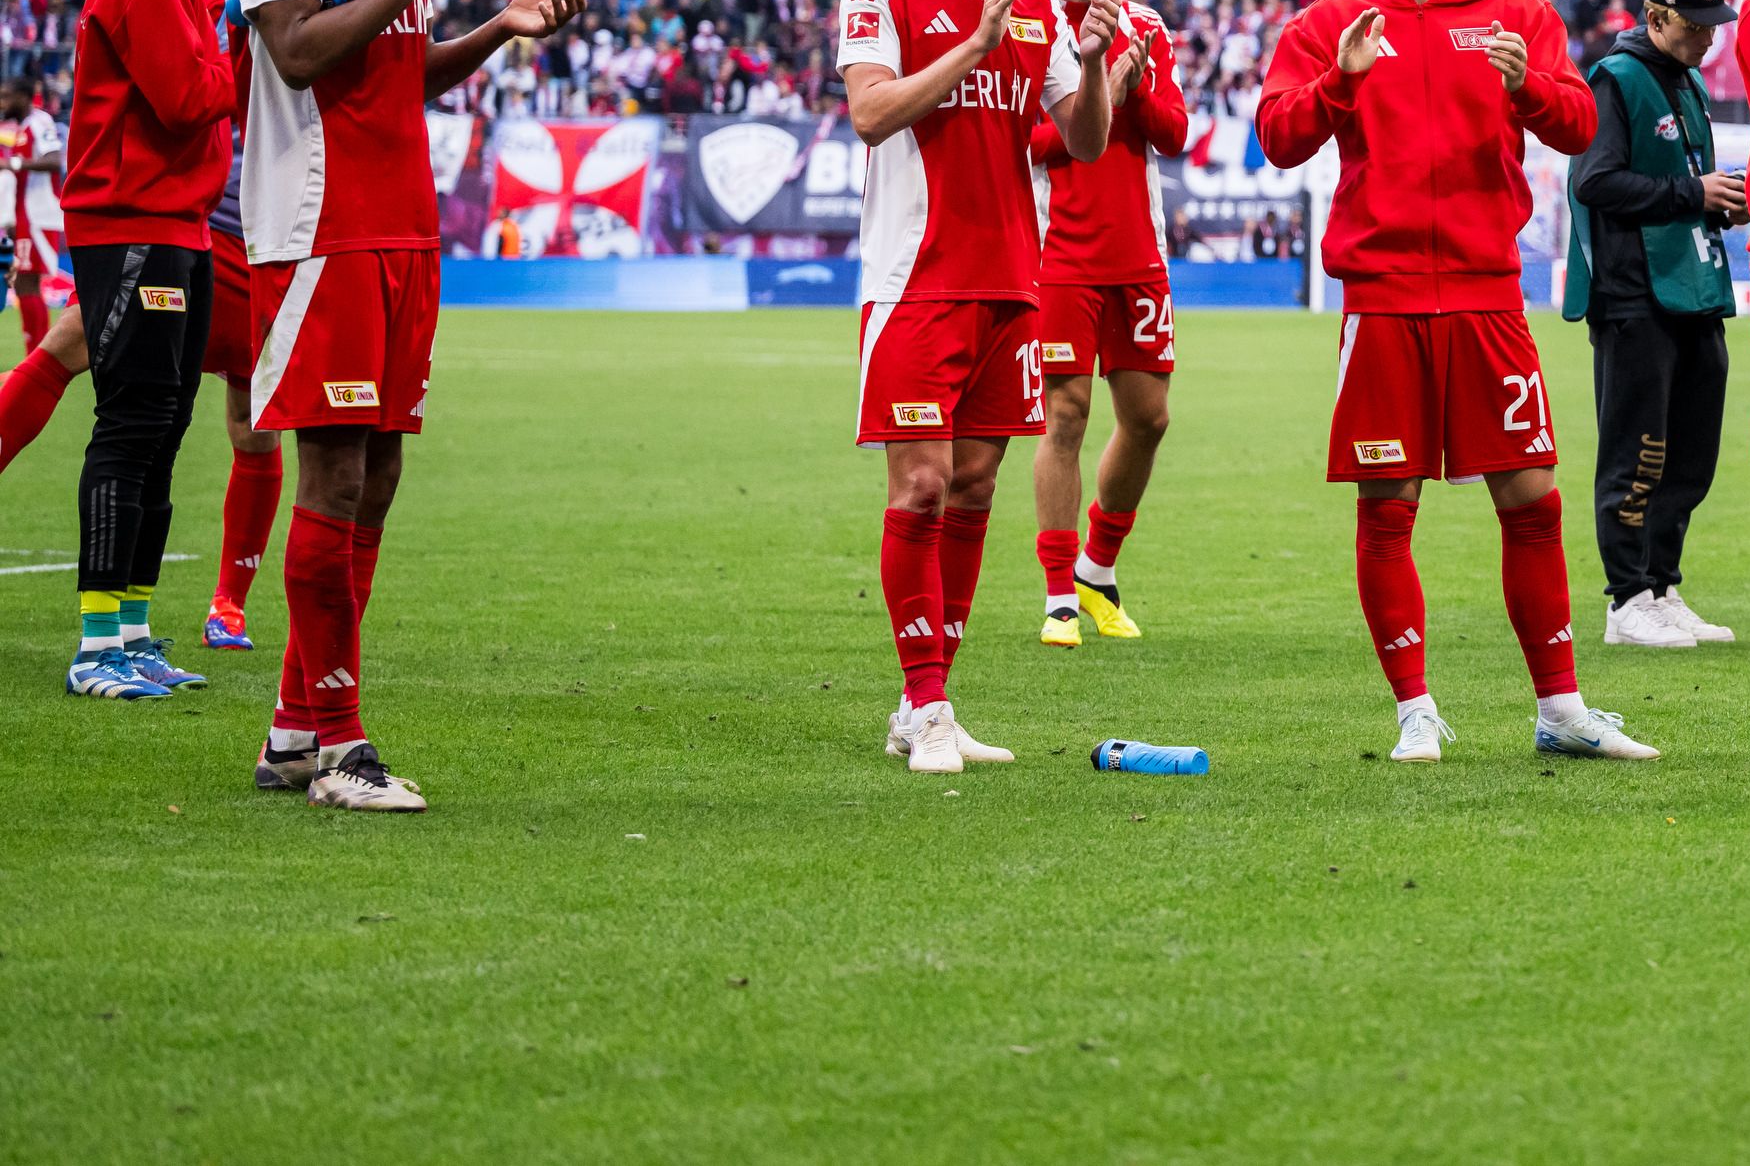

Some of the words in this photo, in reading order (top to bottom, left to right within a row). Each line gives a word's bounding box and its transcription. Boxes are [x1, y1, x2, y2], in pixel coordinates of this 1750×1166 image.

[1133, 294, 1174, 343] 24
[356, 391, 375, 400] UNION
[1503, 371, 1547, 431] 21
[919, 411, 938, 420] UNION
[1382, 448, 1401, 457] UNION
